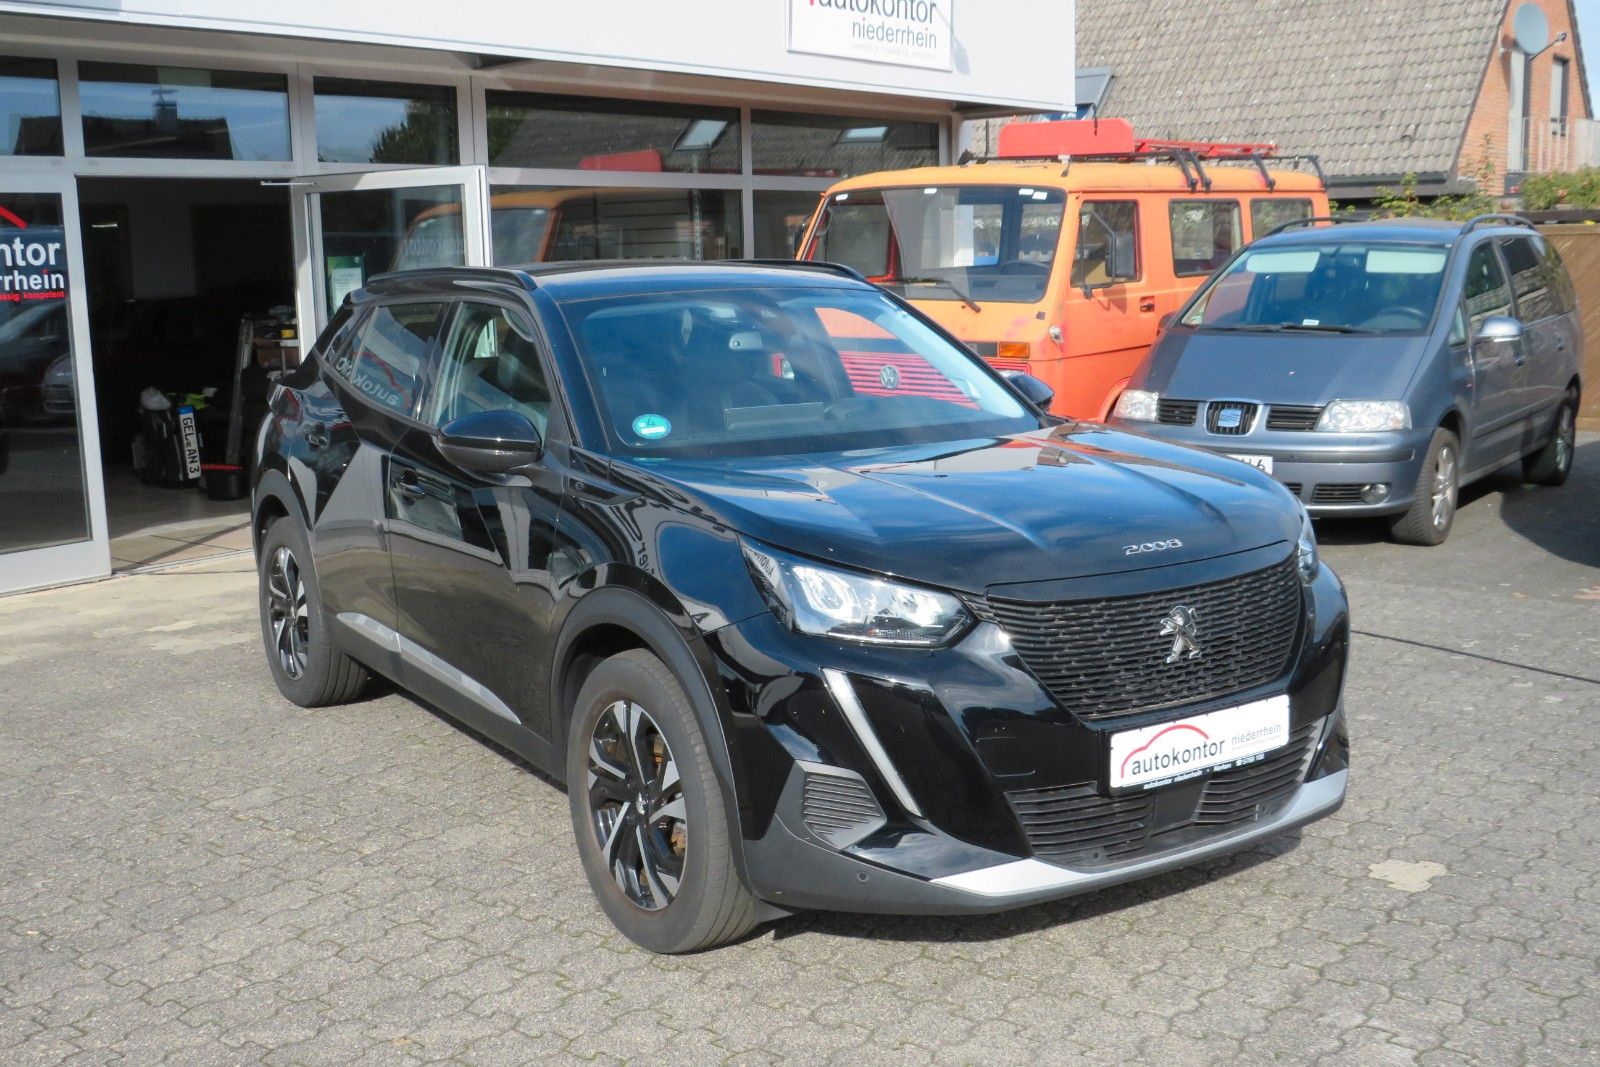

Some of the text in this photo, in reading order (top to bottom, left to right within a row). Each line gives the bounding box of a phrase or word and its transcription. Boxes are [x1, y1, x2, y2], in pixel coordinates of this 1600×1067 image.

[852, 17, 937, 49] niederrhein
[0, 268, 65, 291] rhein
[182, 417, 195, 441] GEL
[187, 449, 198, 464] AN
[1122, 538, 1183, 556] 2008
[1132, 739, 1225, 775] autokontor
[1231, 722, 1281, 746] niederrhein
